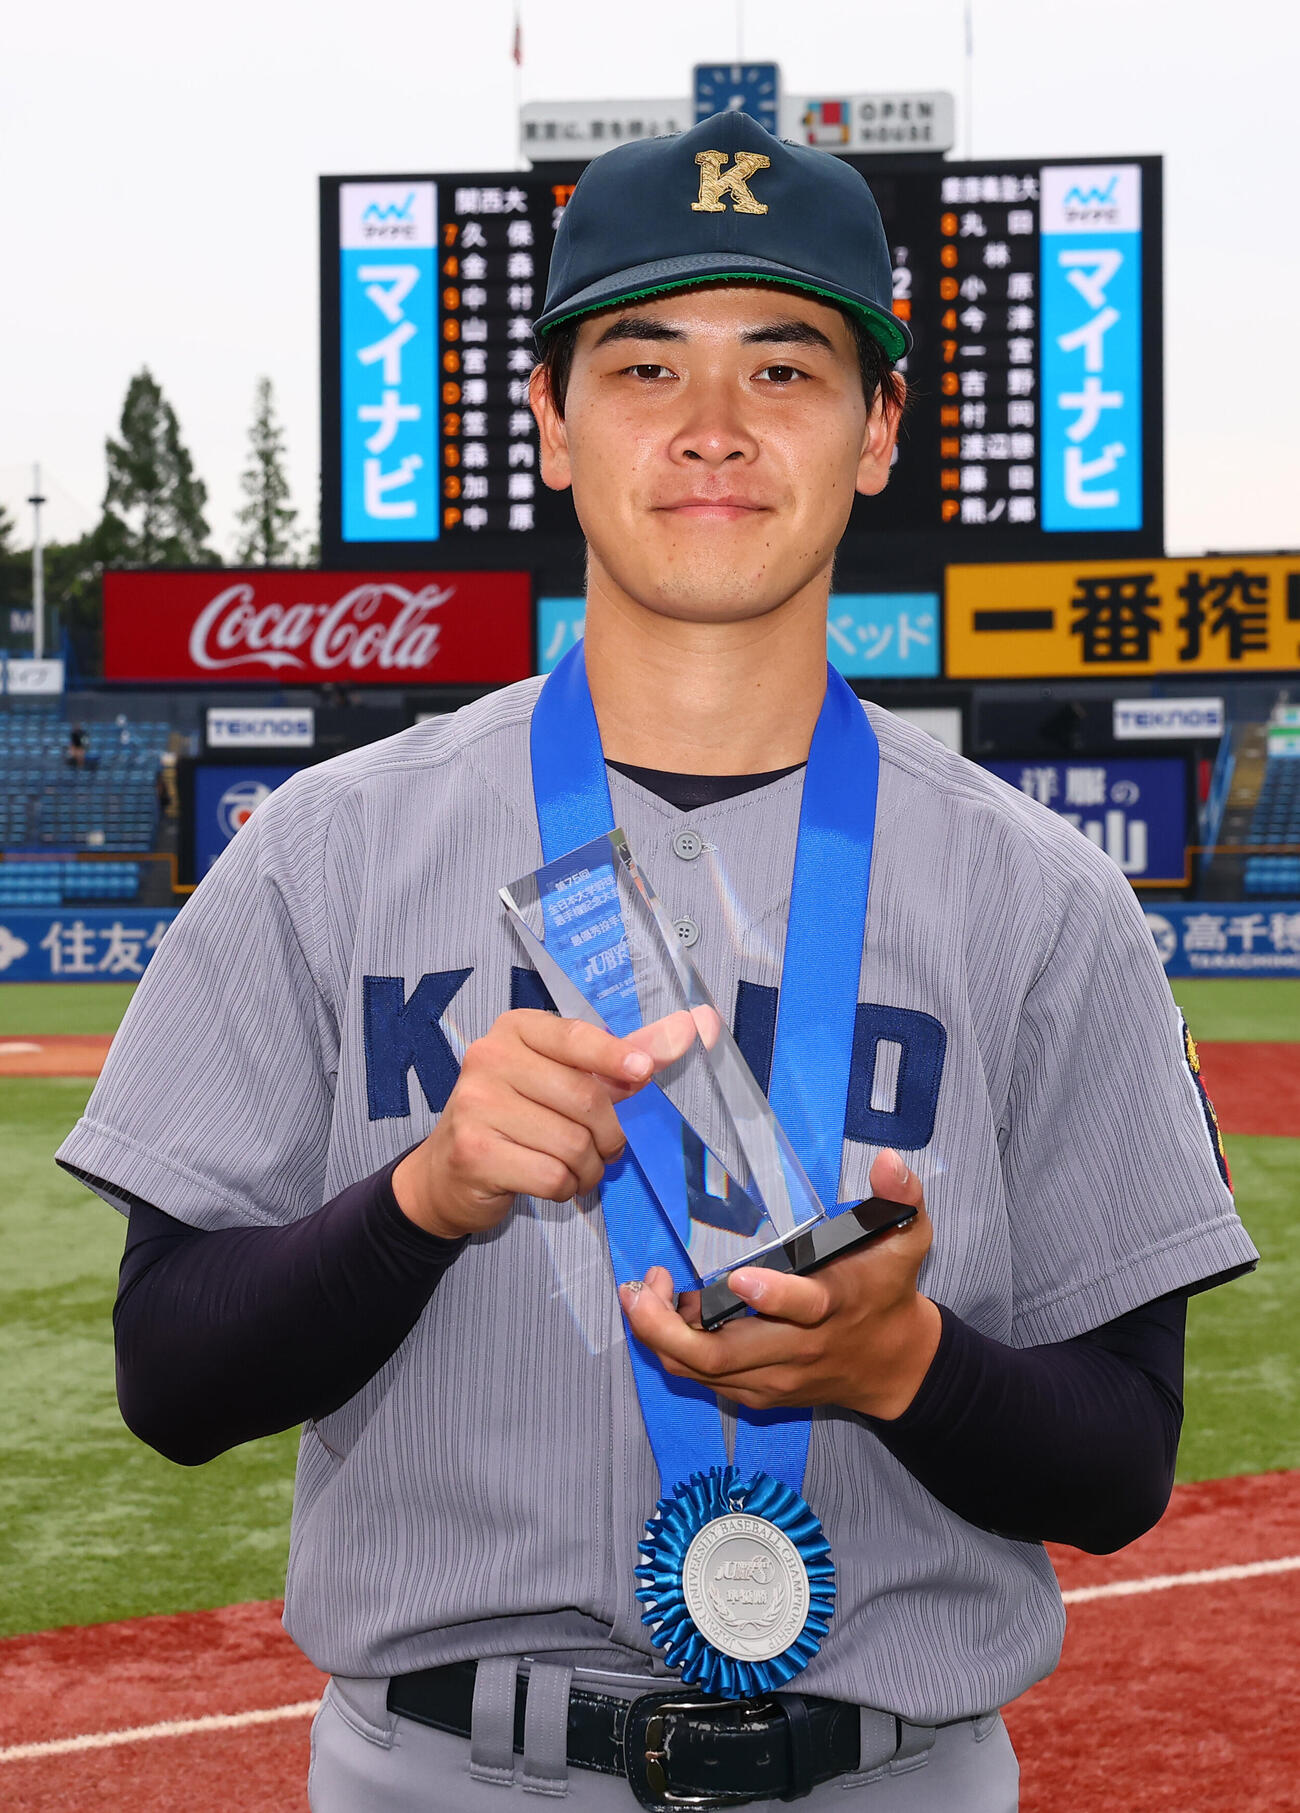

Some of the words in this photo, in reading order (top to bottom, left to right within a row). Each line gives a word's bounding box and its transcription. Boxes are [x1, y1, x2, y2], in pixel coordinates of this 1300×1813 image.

[861, 103, 932, 119] OPEN
[691, 150, 771, 215] K
[445, 224, 458, 245] 7
[944, 340, 957, 362] 7
[357, 264, 422, 519] マイナビ
[1057, 249, 1126, 509] マイナビ
[445, 508, 460, 528] P
[942, 500, 959, 520] P
[189, 583, 457, 670] Coca-Cola
[720, 1519, 784, 1550] BASEBALL
[688, 1528, 718, 1612] UNIVERSITY
[769, 1549, 803, 1650] CHAMPIONSHIP
[698, 1613, 736, 1649] JAPAN
